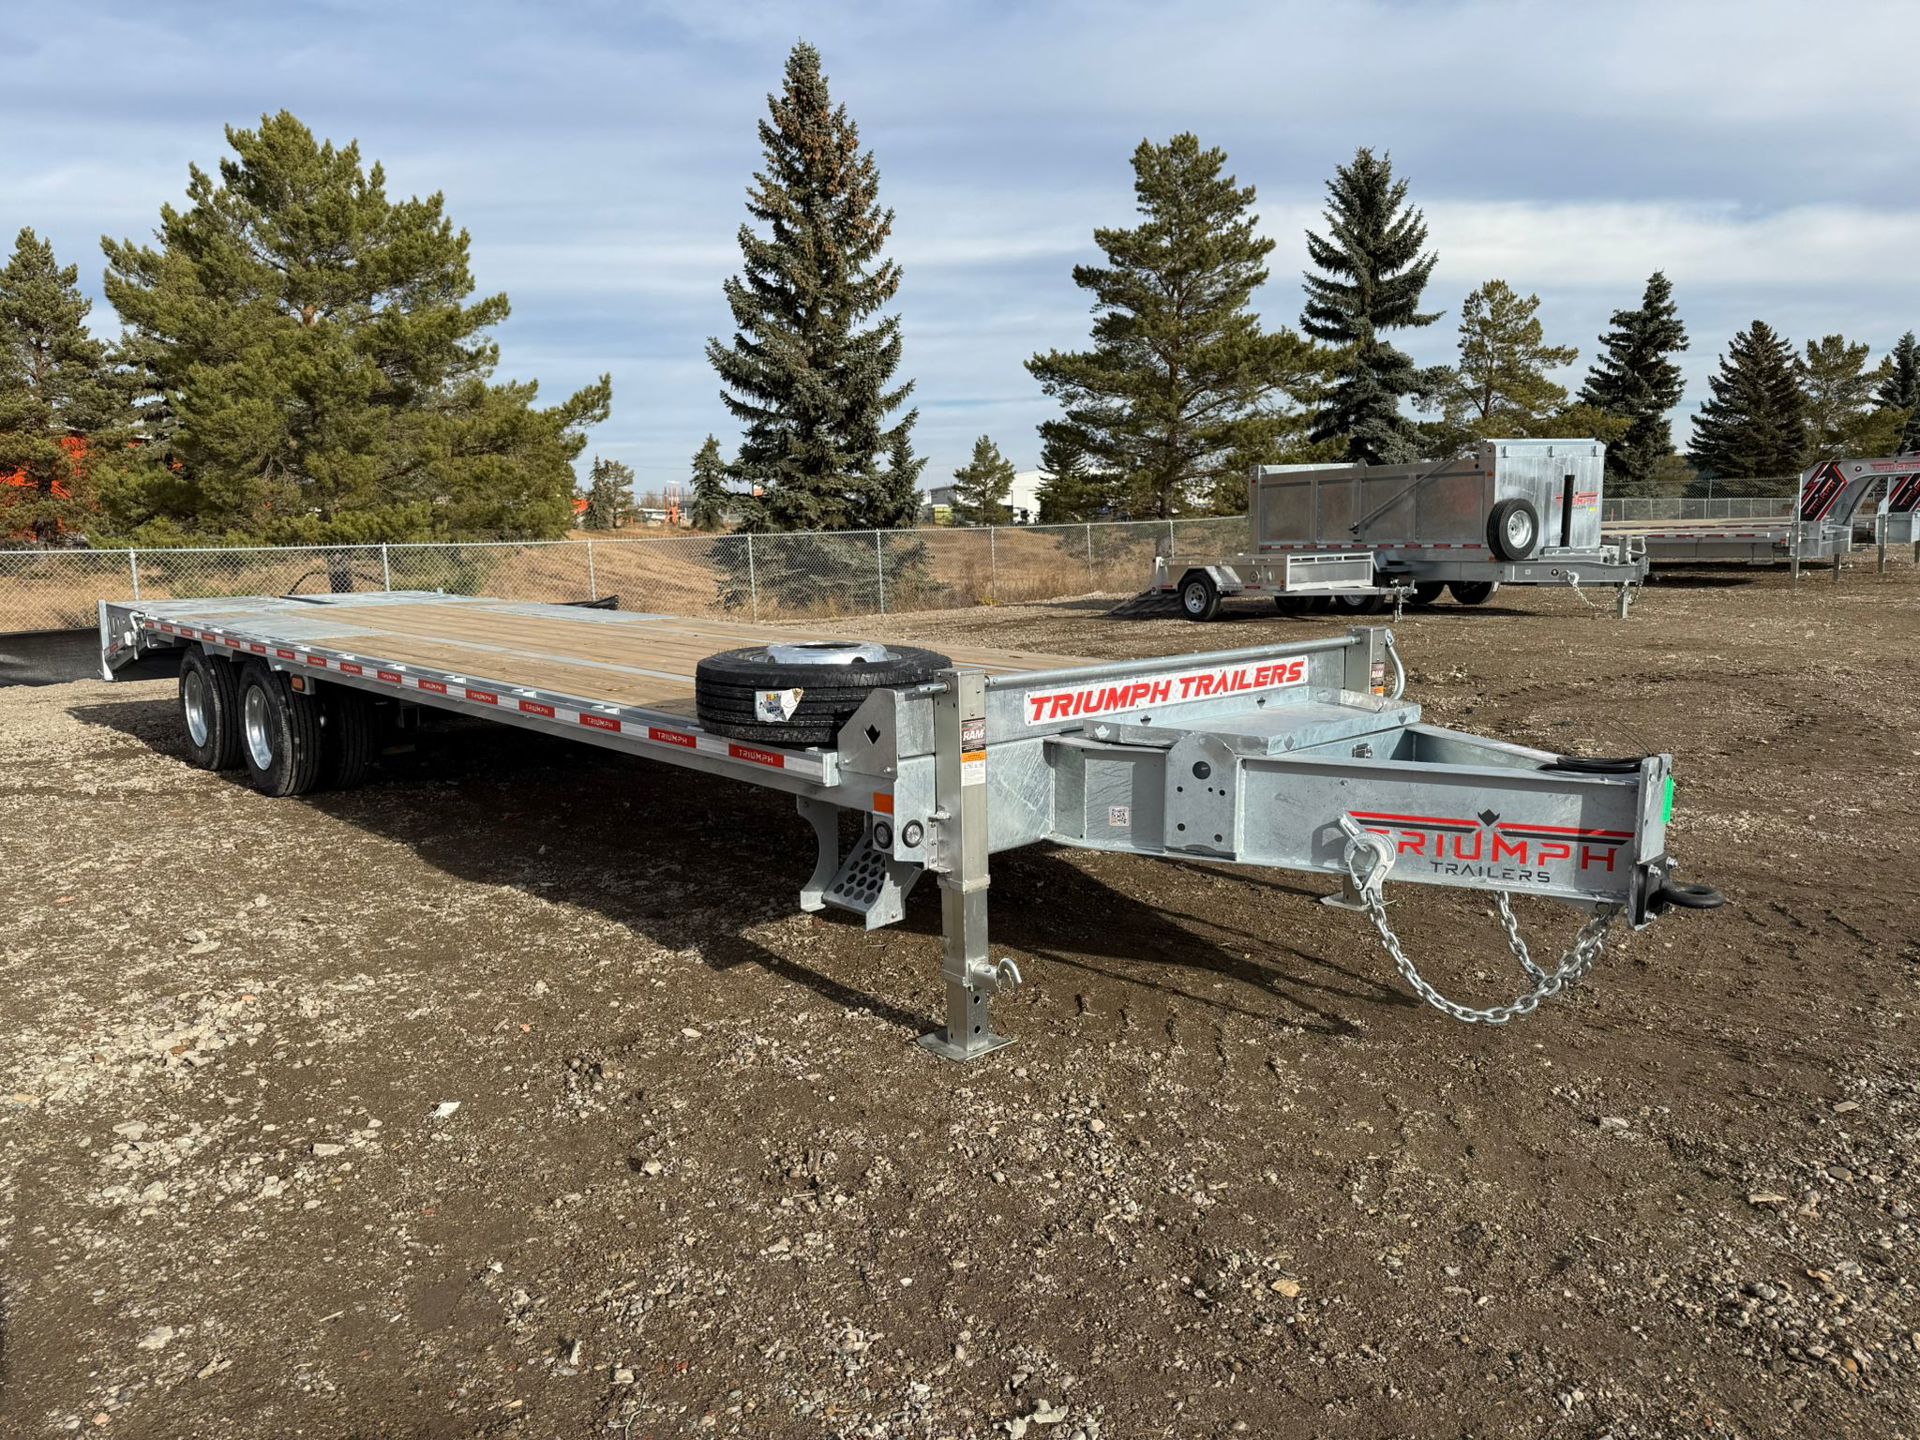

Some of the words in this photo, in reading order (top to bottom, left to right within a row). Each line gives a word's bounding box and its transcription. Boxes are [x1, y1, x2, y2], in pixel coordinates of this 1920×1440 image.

[470, 691, 493, 702] TRIUMPH
[1030, 680, 1171, 721] TRIUMPH
[1179, 661, 1304, 697] TRAILERS
[525, 703, 549, 714] TRIUMPH
[586, 716, 614, 729] TRIUMPH
[656, 731, 688, 745] TRIUMPH
[738, 749, 774, 764] TRIUMPH
[1430, 861, 1551, 883] TRAILERS
